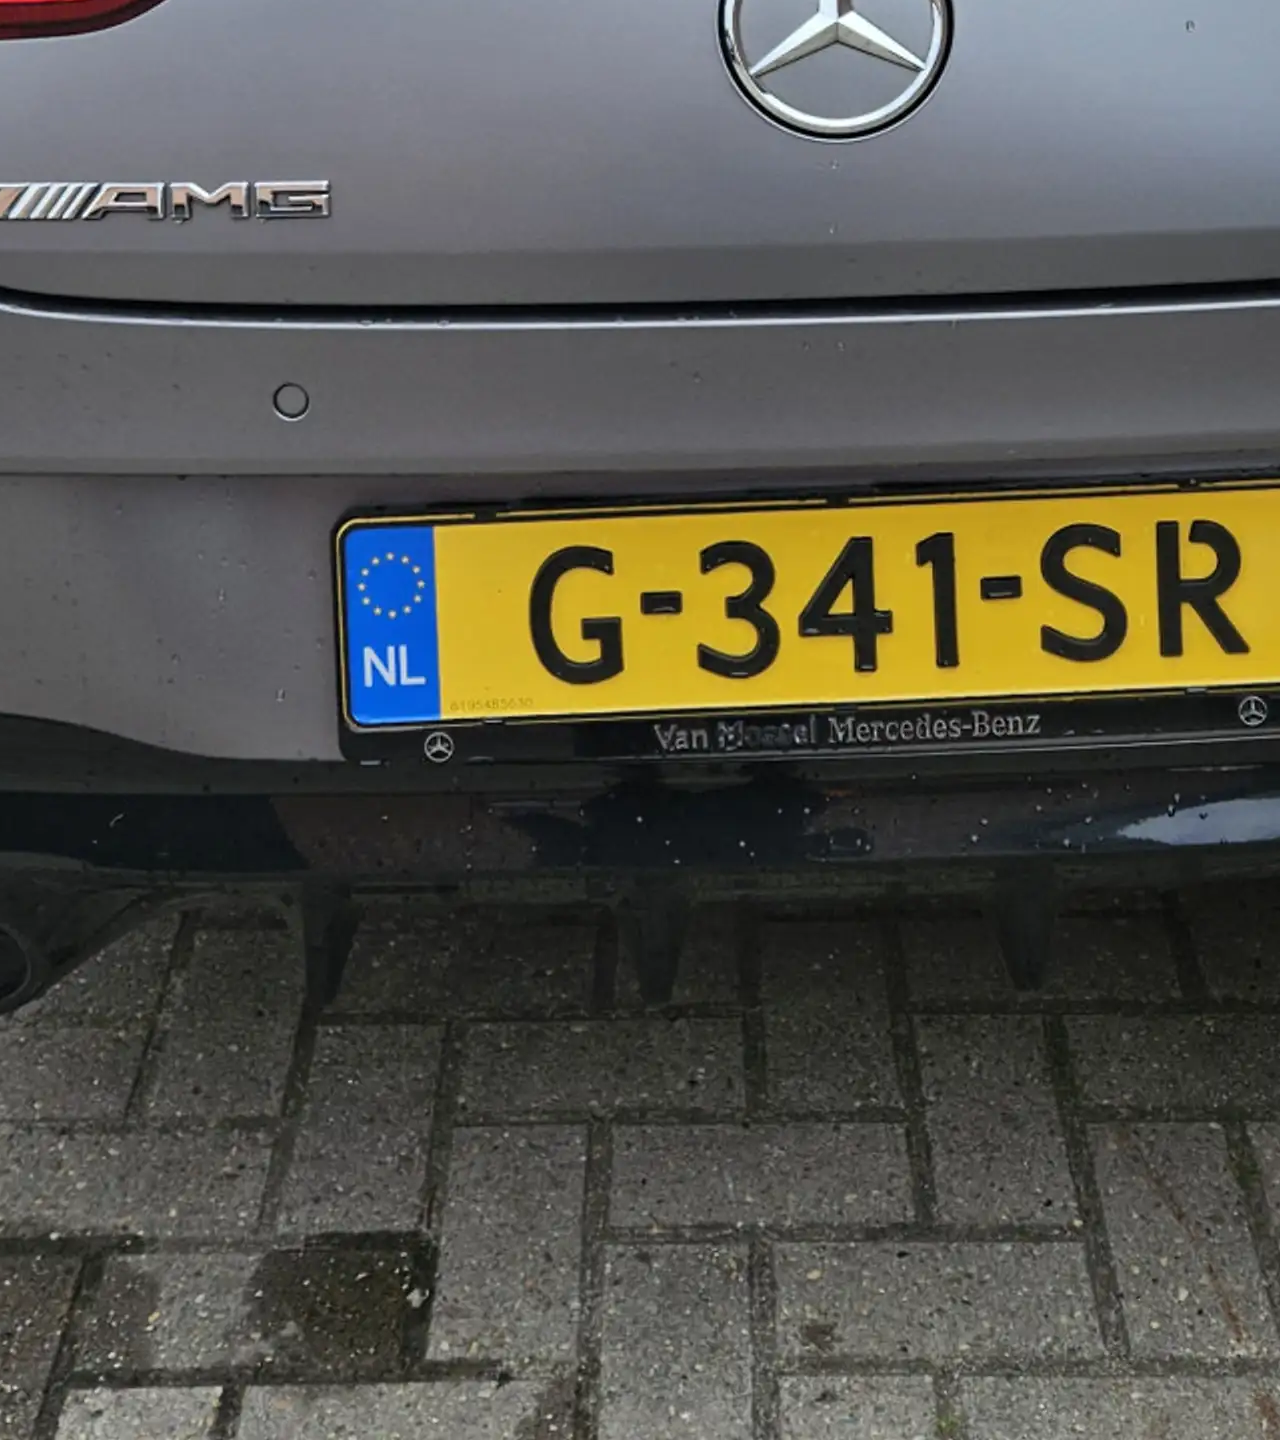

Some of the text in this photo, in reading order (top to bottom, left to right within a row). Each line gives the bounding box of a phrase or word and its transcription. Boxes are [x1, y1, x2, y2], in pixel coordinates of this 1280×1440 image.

[82, 180, 331, 222] AMG
[530, 518, 1250, 685] G-341-SR
[363, 644, 427, 687] NL
[654, 723, 709, 751] Van
[827, 711, 1041, 744] Mercedes-Benz
